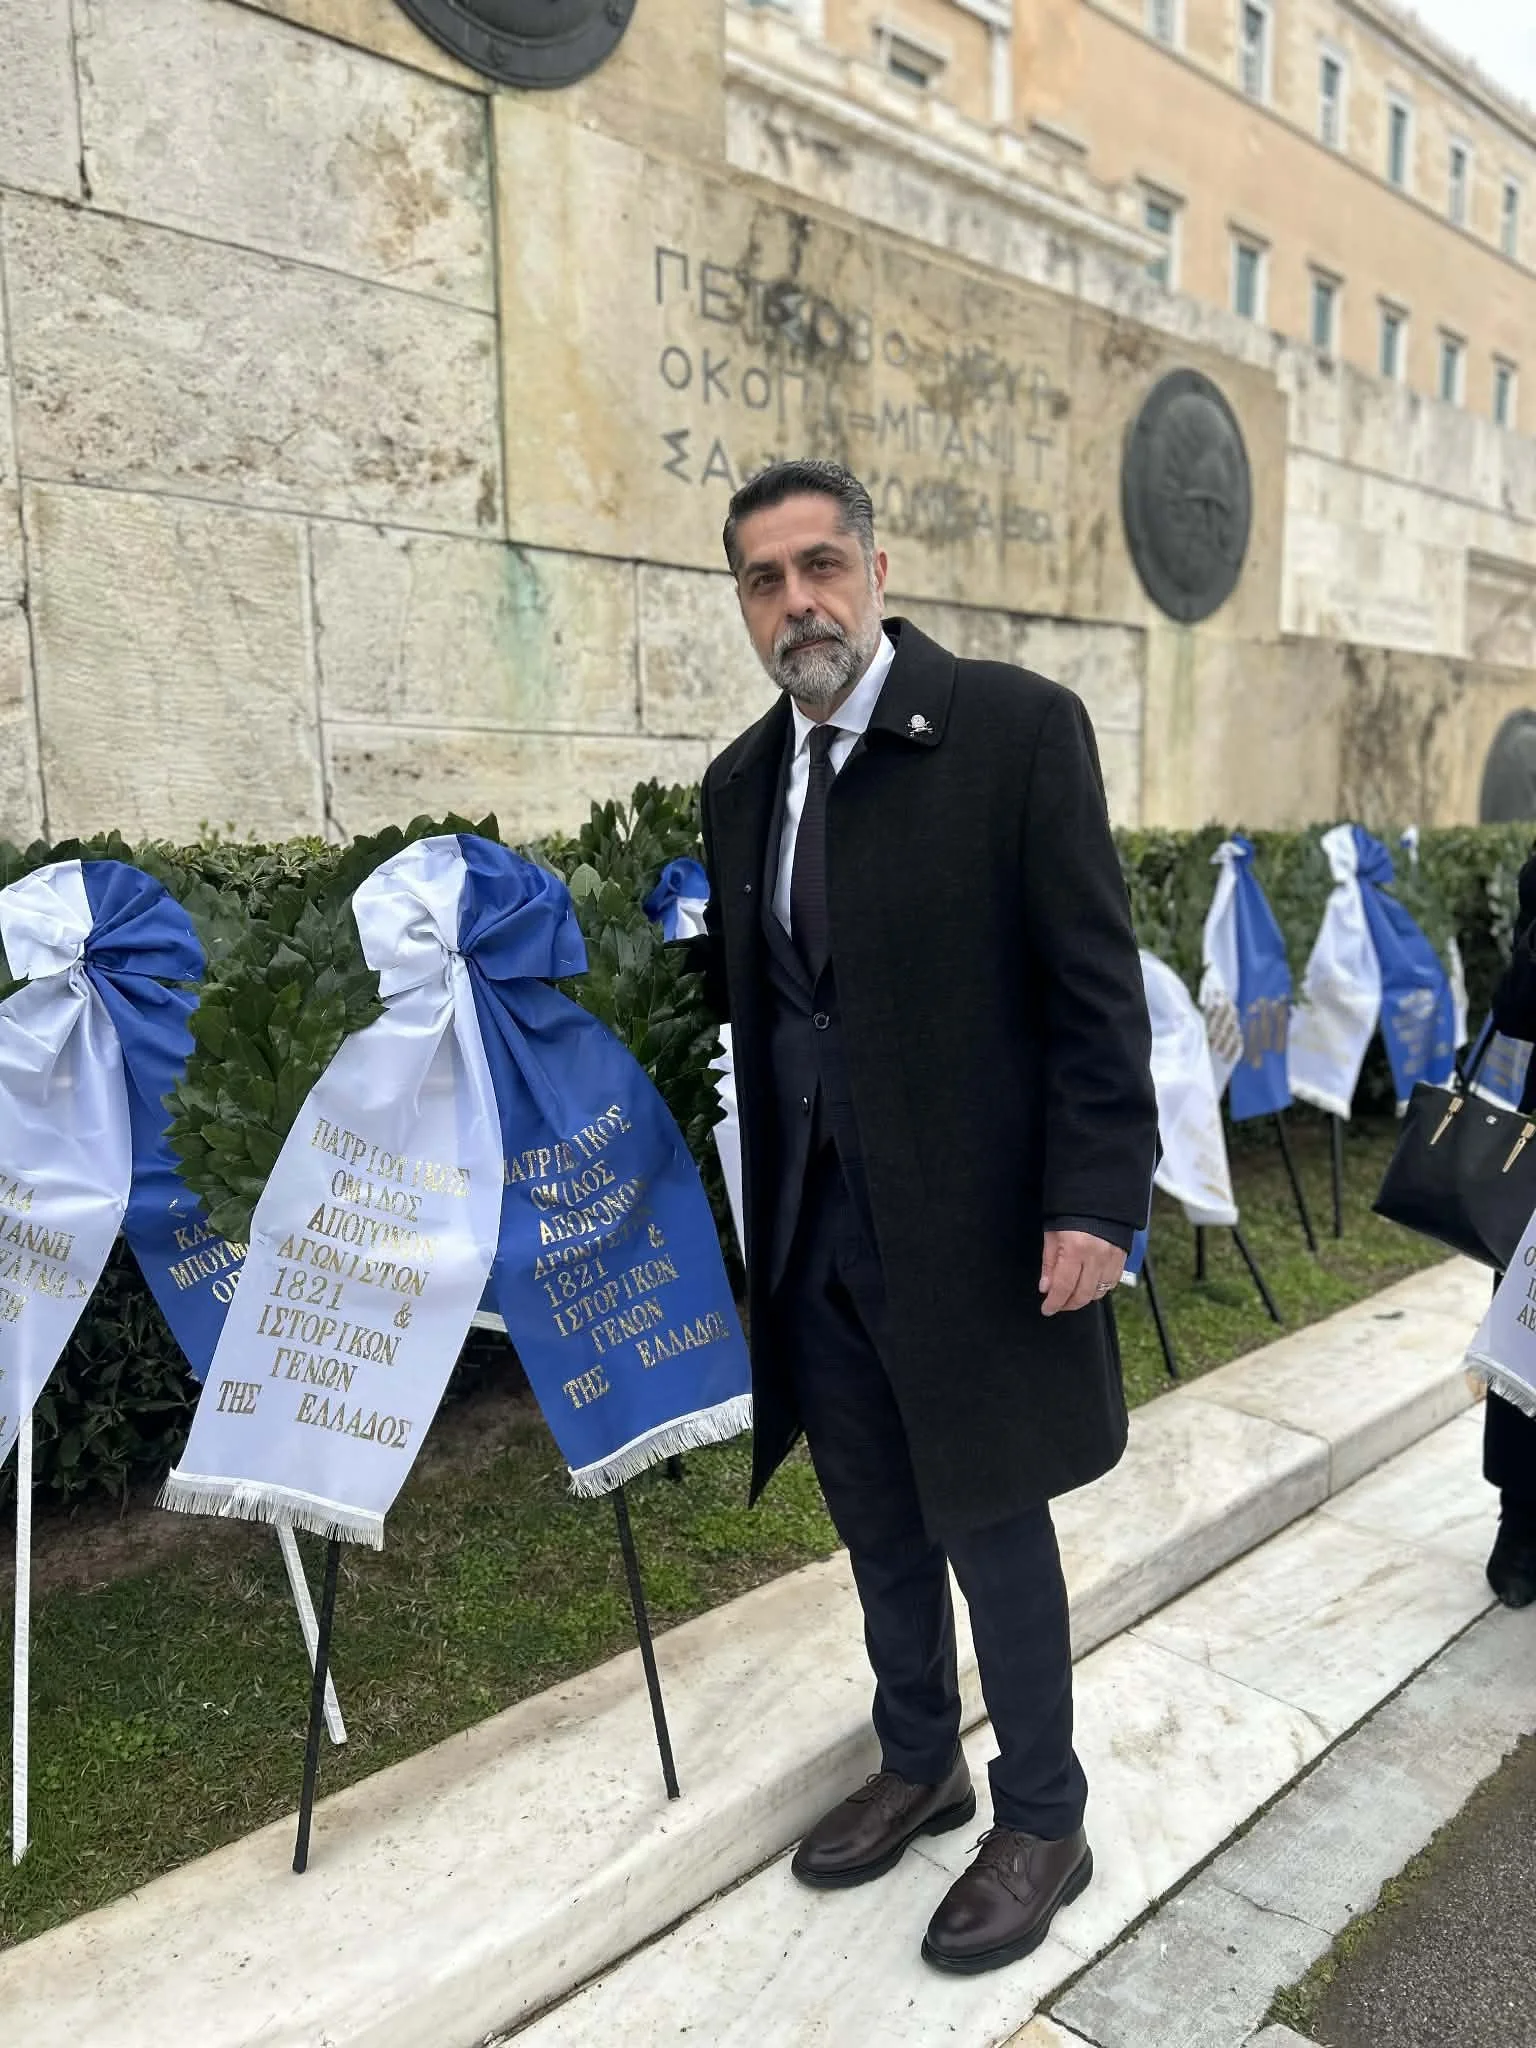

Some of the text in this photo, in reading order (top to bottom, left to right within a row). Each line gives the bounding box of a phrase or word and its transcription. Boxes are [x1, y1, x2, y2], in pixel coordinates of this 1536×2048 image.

[277, 1233, 430, 1297] ΑΓΩΝΙΣΤΩΝ
[543, 1257, 608, 1308] 1821
[553, 1253, 680, 1337] ΙΣΤΟΡΙΚΩΝ
[269, 1266, 413, 1329] 1821 &
[591, 1297, 664, 1354] ΓΕΝΩΝ
[256, 1304, 402, 1367] ΙΣΤΟΡΙΚΩΝ
[269, 1347, 358, 1393] ΓΕΝΩΝ
[563, 1365, 610, 1409] ΤΗΣ
[216, 1380, 413, 1449] ΤΗΣ ΕΛΛΑΔΟΣ
